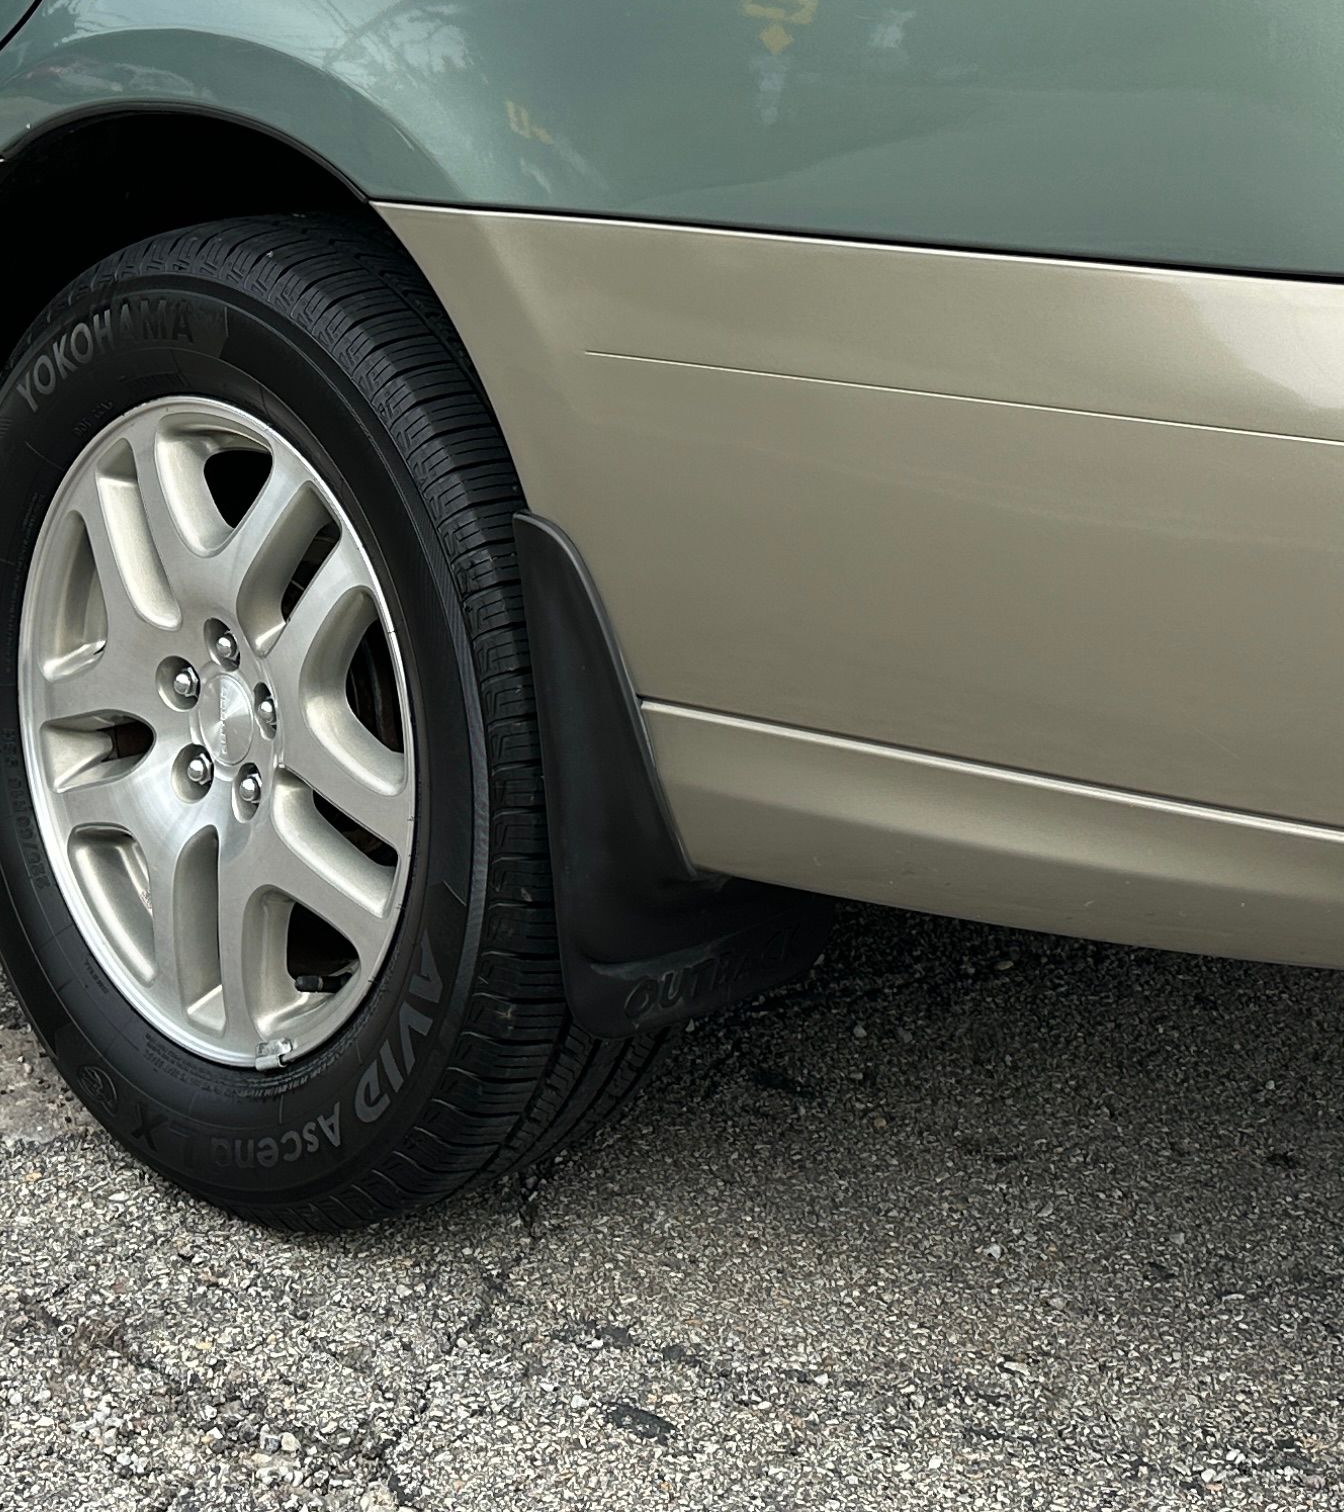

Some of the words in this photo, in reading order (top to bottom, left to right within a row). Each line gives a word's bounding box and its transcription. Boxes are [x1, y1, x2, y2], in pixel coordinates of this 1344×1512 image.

[16, 298, 195, 413] YOKOHAMA
[355, 928, 445, 1124] AVID
[210, 1100, 342, 1169] Ascend
